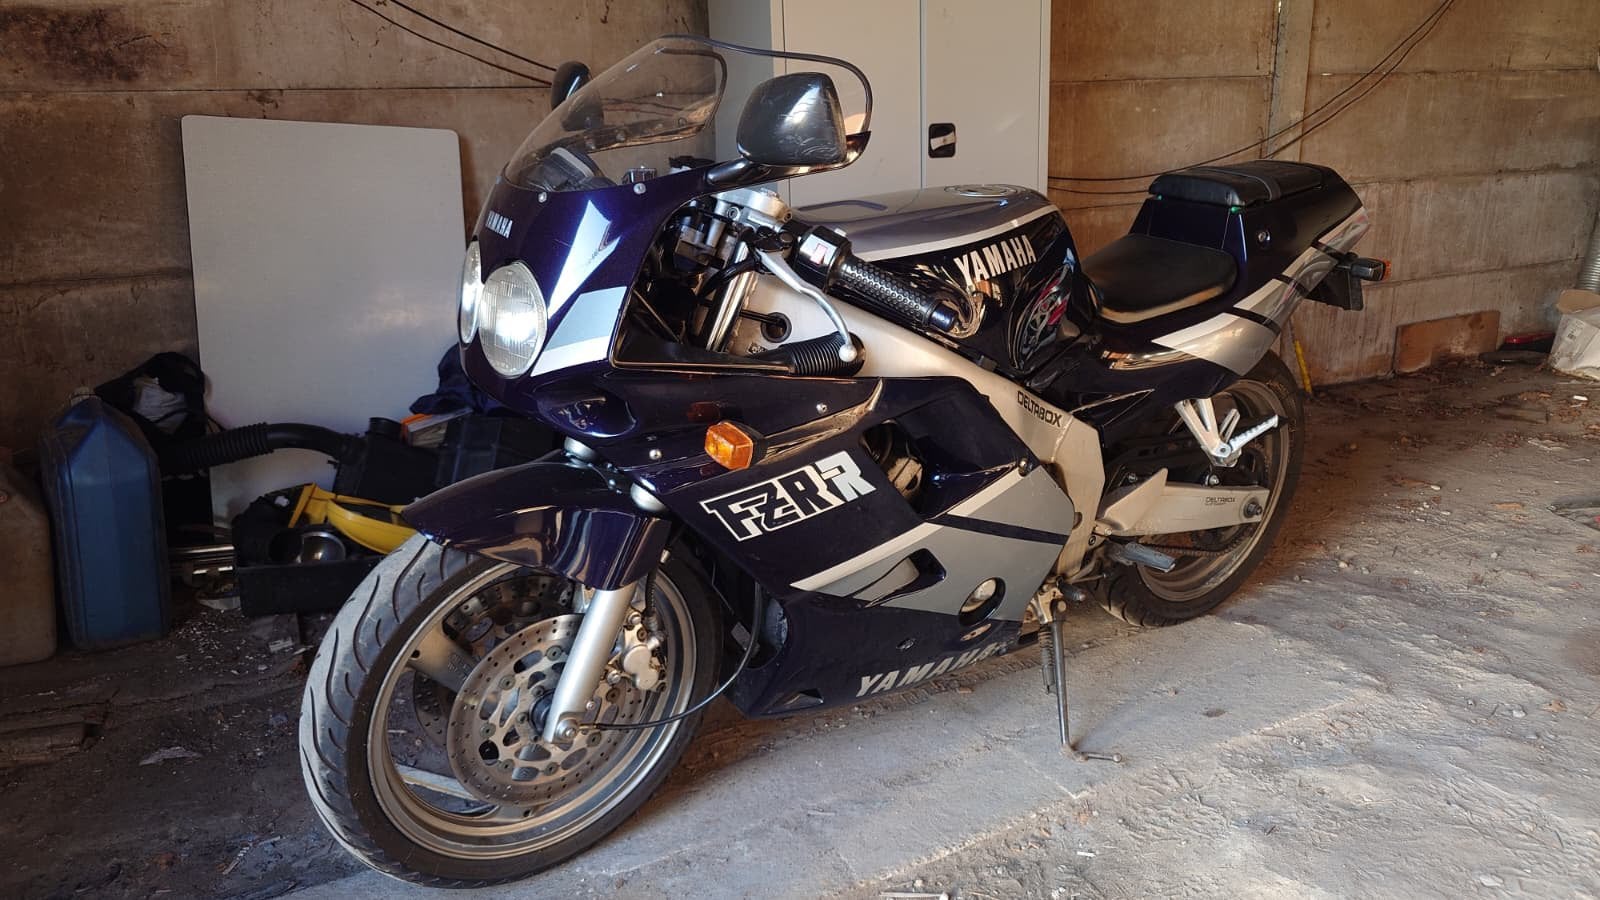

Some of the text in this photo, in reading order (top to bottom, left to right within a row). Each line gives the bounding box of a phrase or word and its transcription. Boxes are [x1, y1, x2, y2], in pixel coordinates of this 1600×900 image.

[953, 234, 1037, 291] YAMAHA
[1017, 390, 1063, 428] DELTABOX
[855, 641, 1000, 698] YAMAHA
